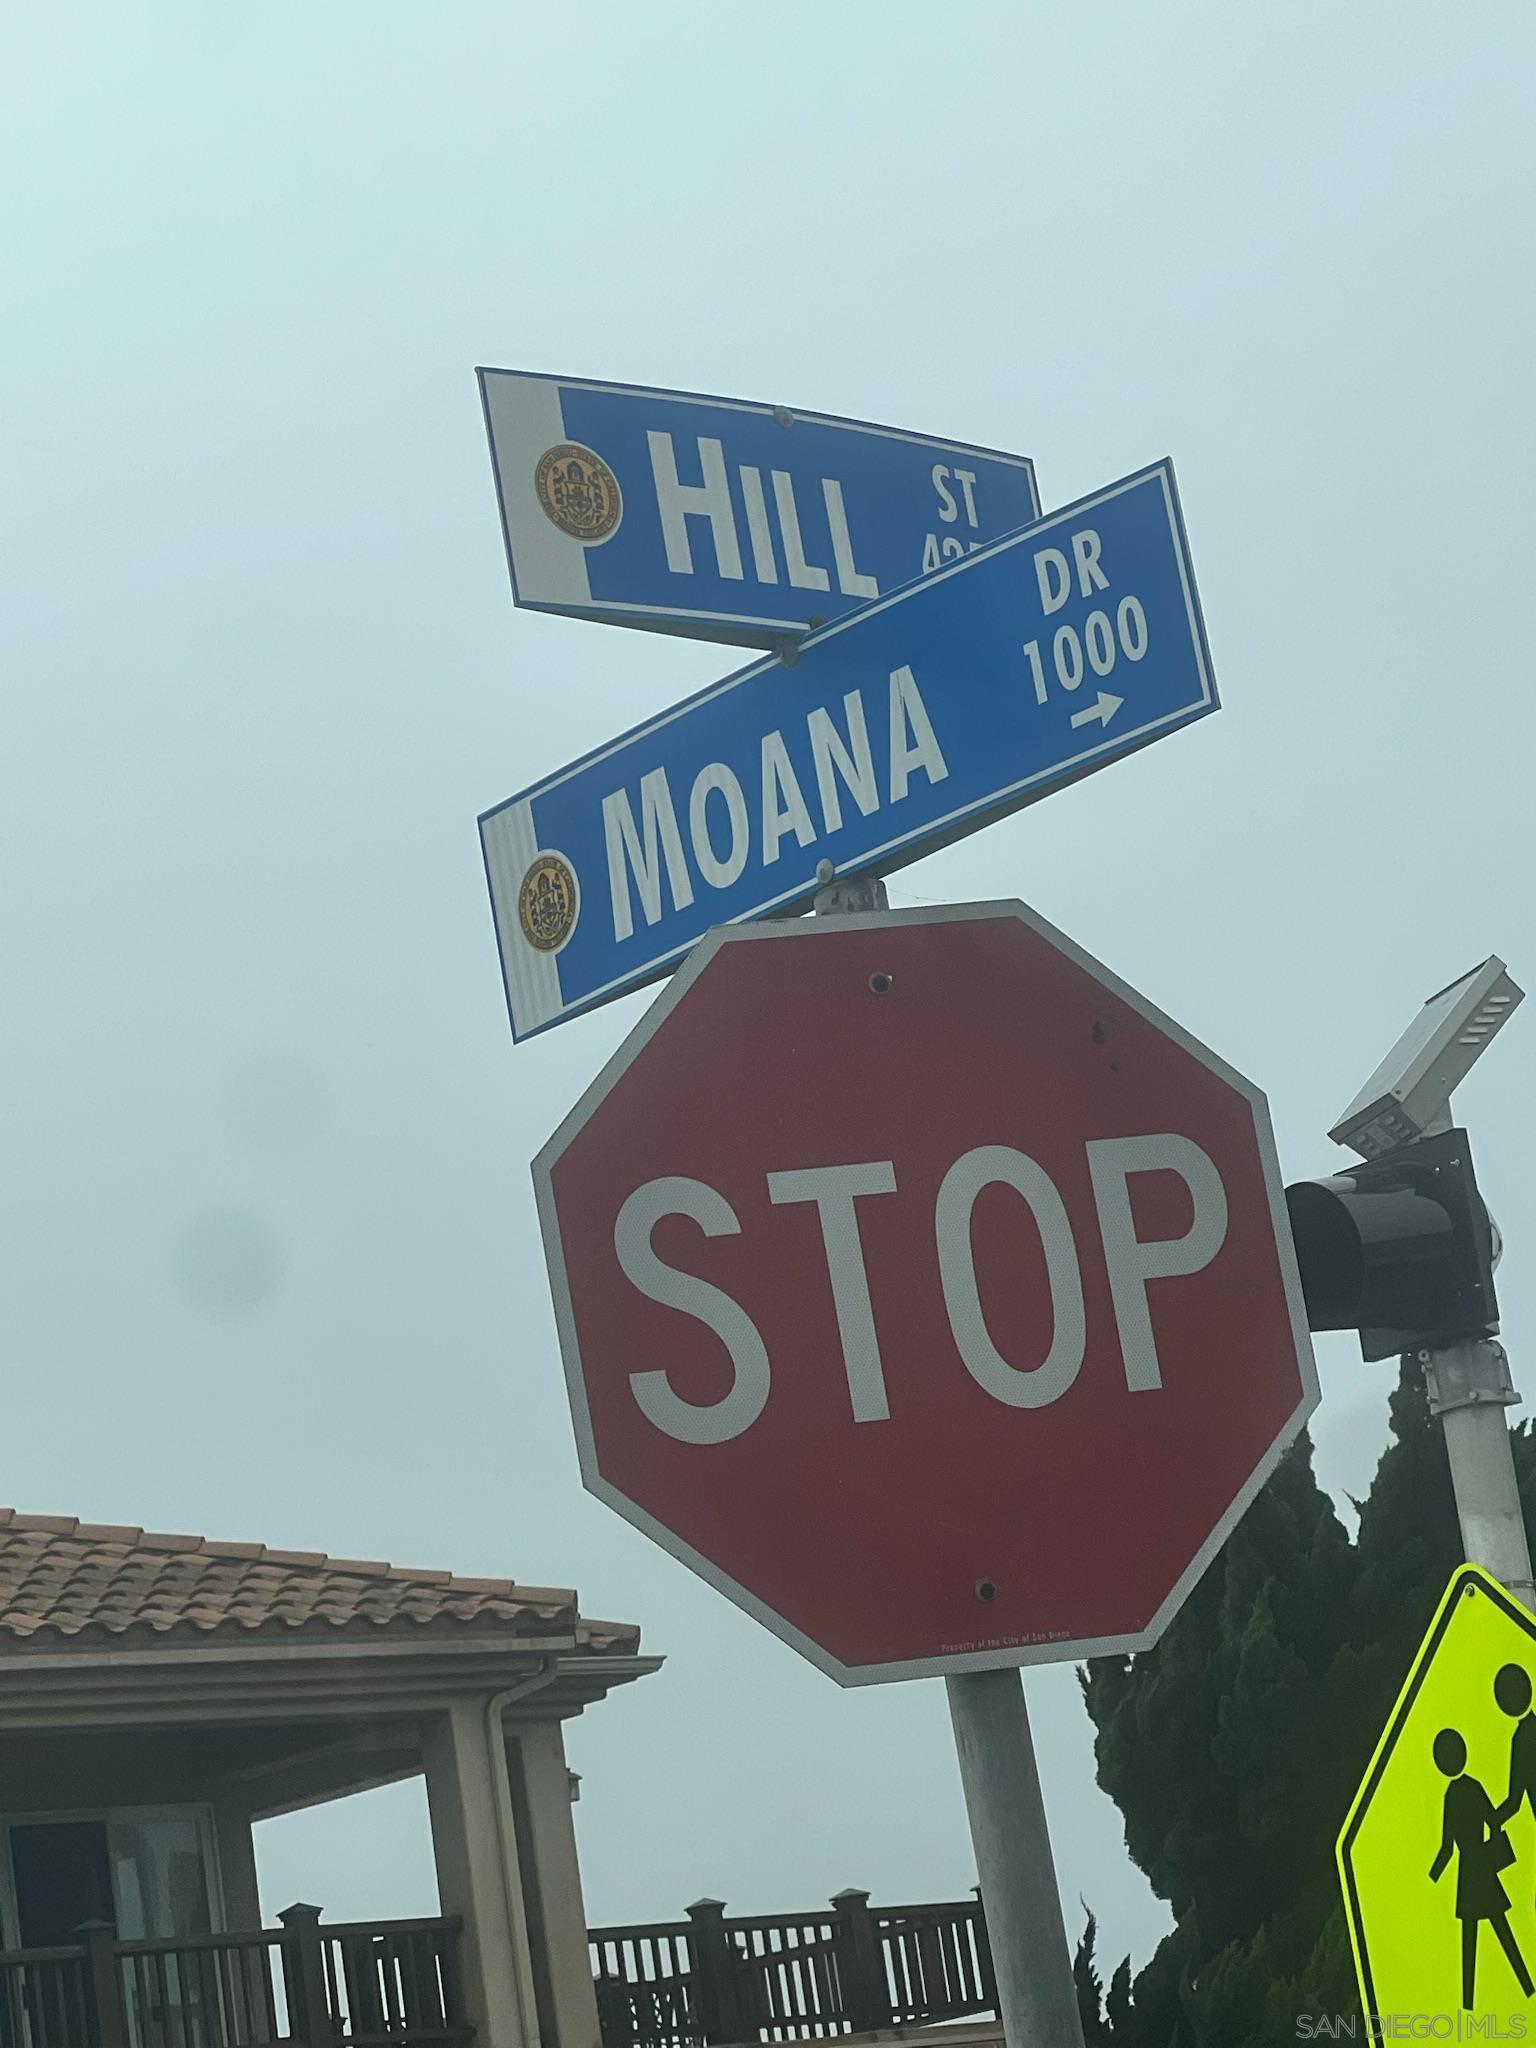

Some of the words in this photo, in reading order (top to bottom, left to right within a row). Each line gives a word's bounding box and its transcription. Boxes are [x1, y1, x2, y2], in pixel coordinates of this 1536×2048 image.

[646, 429, 878, 599] HILL
[932, 464, 978, 528] ST
[1034, 528, 1111, 615] DR
[1023, 595, 1149, 705] 1000
[602, 664, 950, 943] MOANA
[614, 1133, 1228, 1444] STOP
[1003, 1636, 1019, 1646] City
[1032, 1632, 1046, 1641] San
